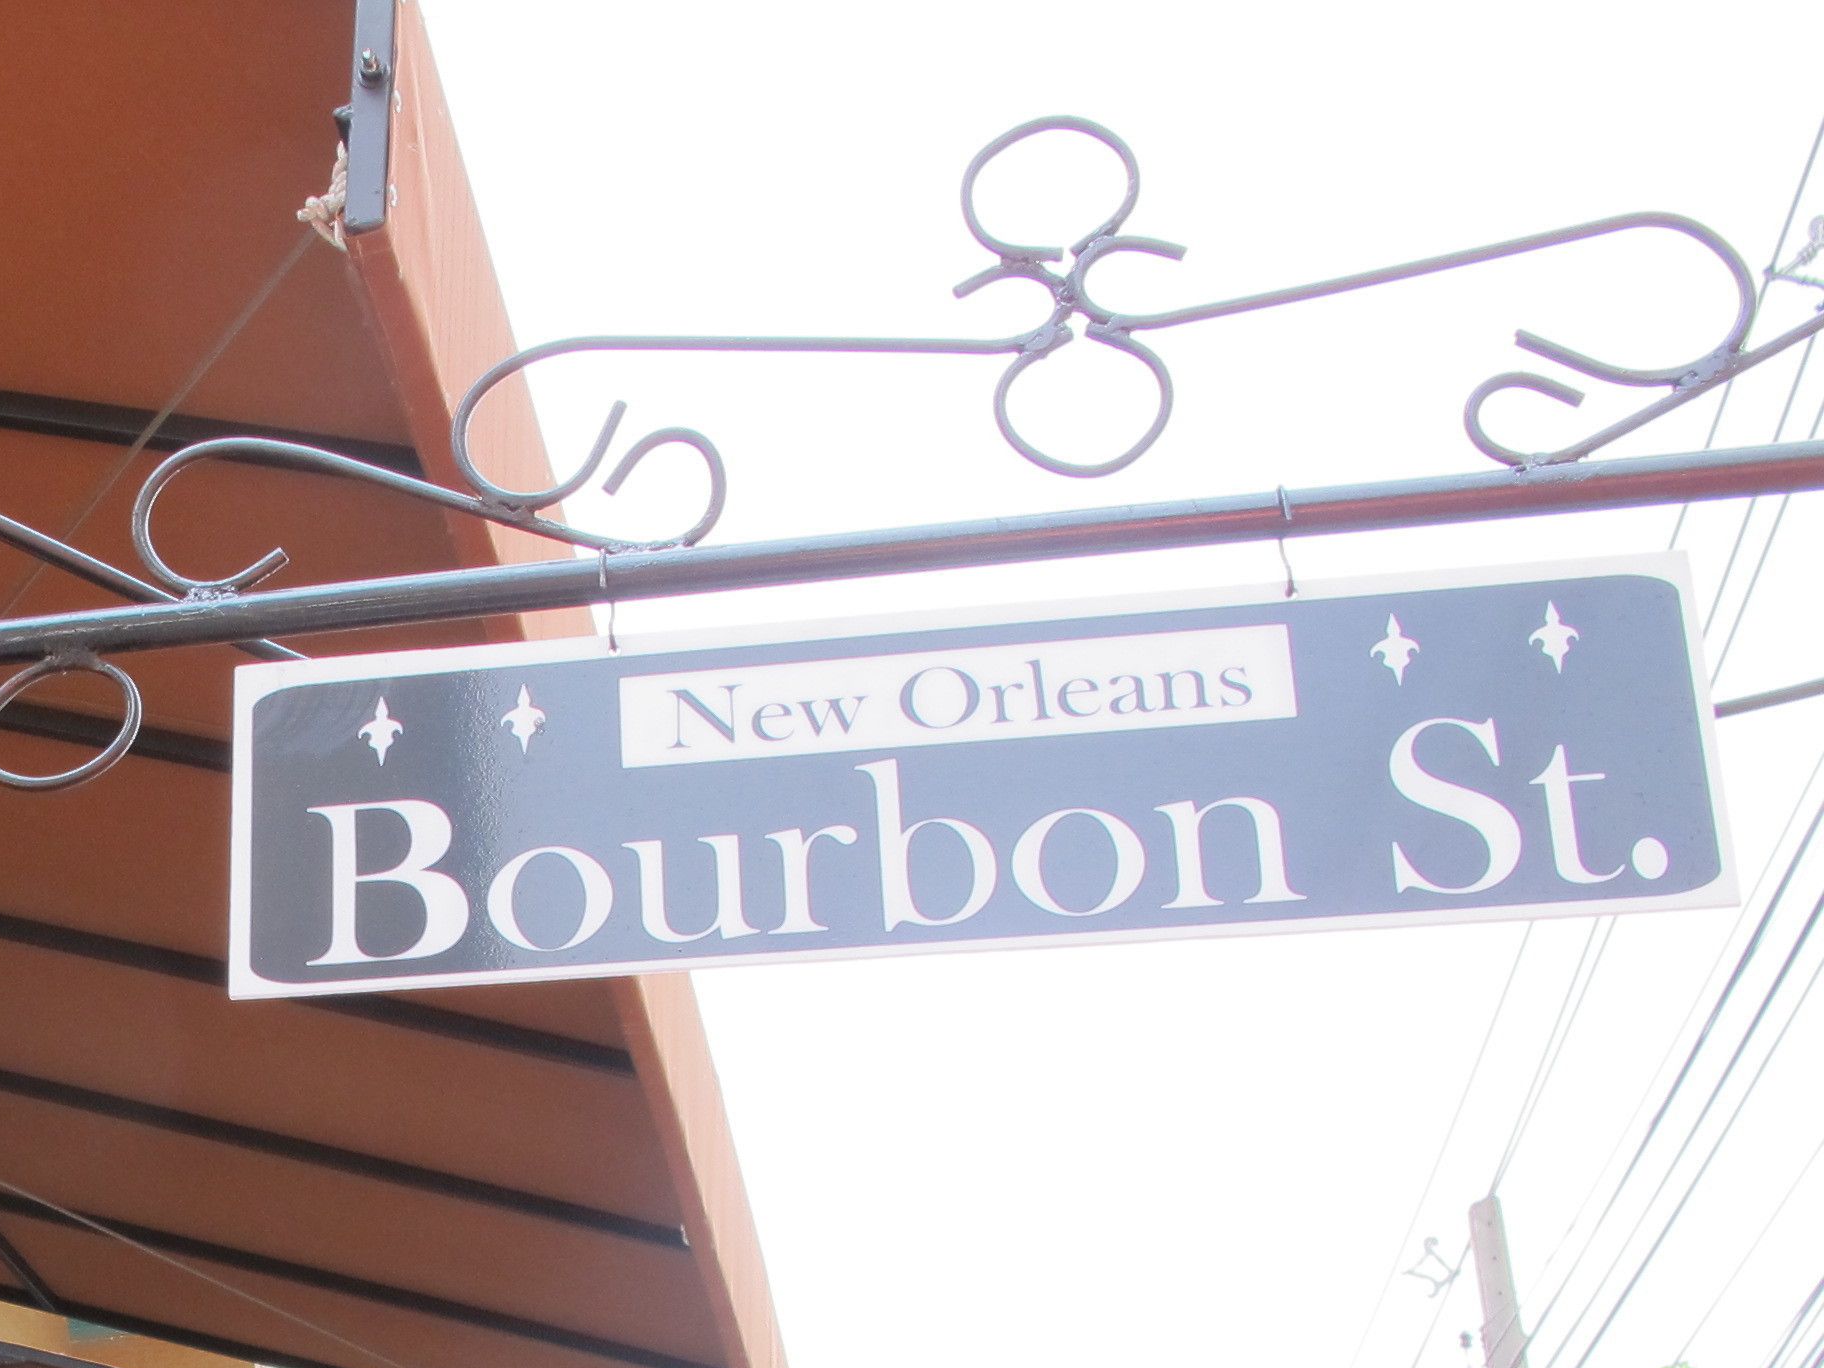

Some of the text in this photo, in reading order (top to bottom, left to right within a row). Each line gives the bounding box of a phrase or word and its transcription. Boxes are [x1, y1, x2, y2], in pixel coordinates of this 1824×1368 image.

[666, 660, 1254, 752] New Orleans
[306, 714, 1671, 968] Bourbon St.
